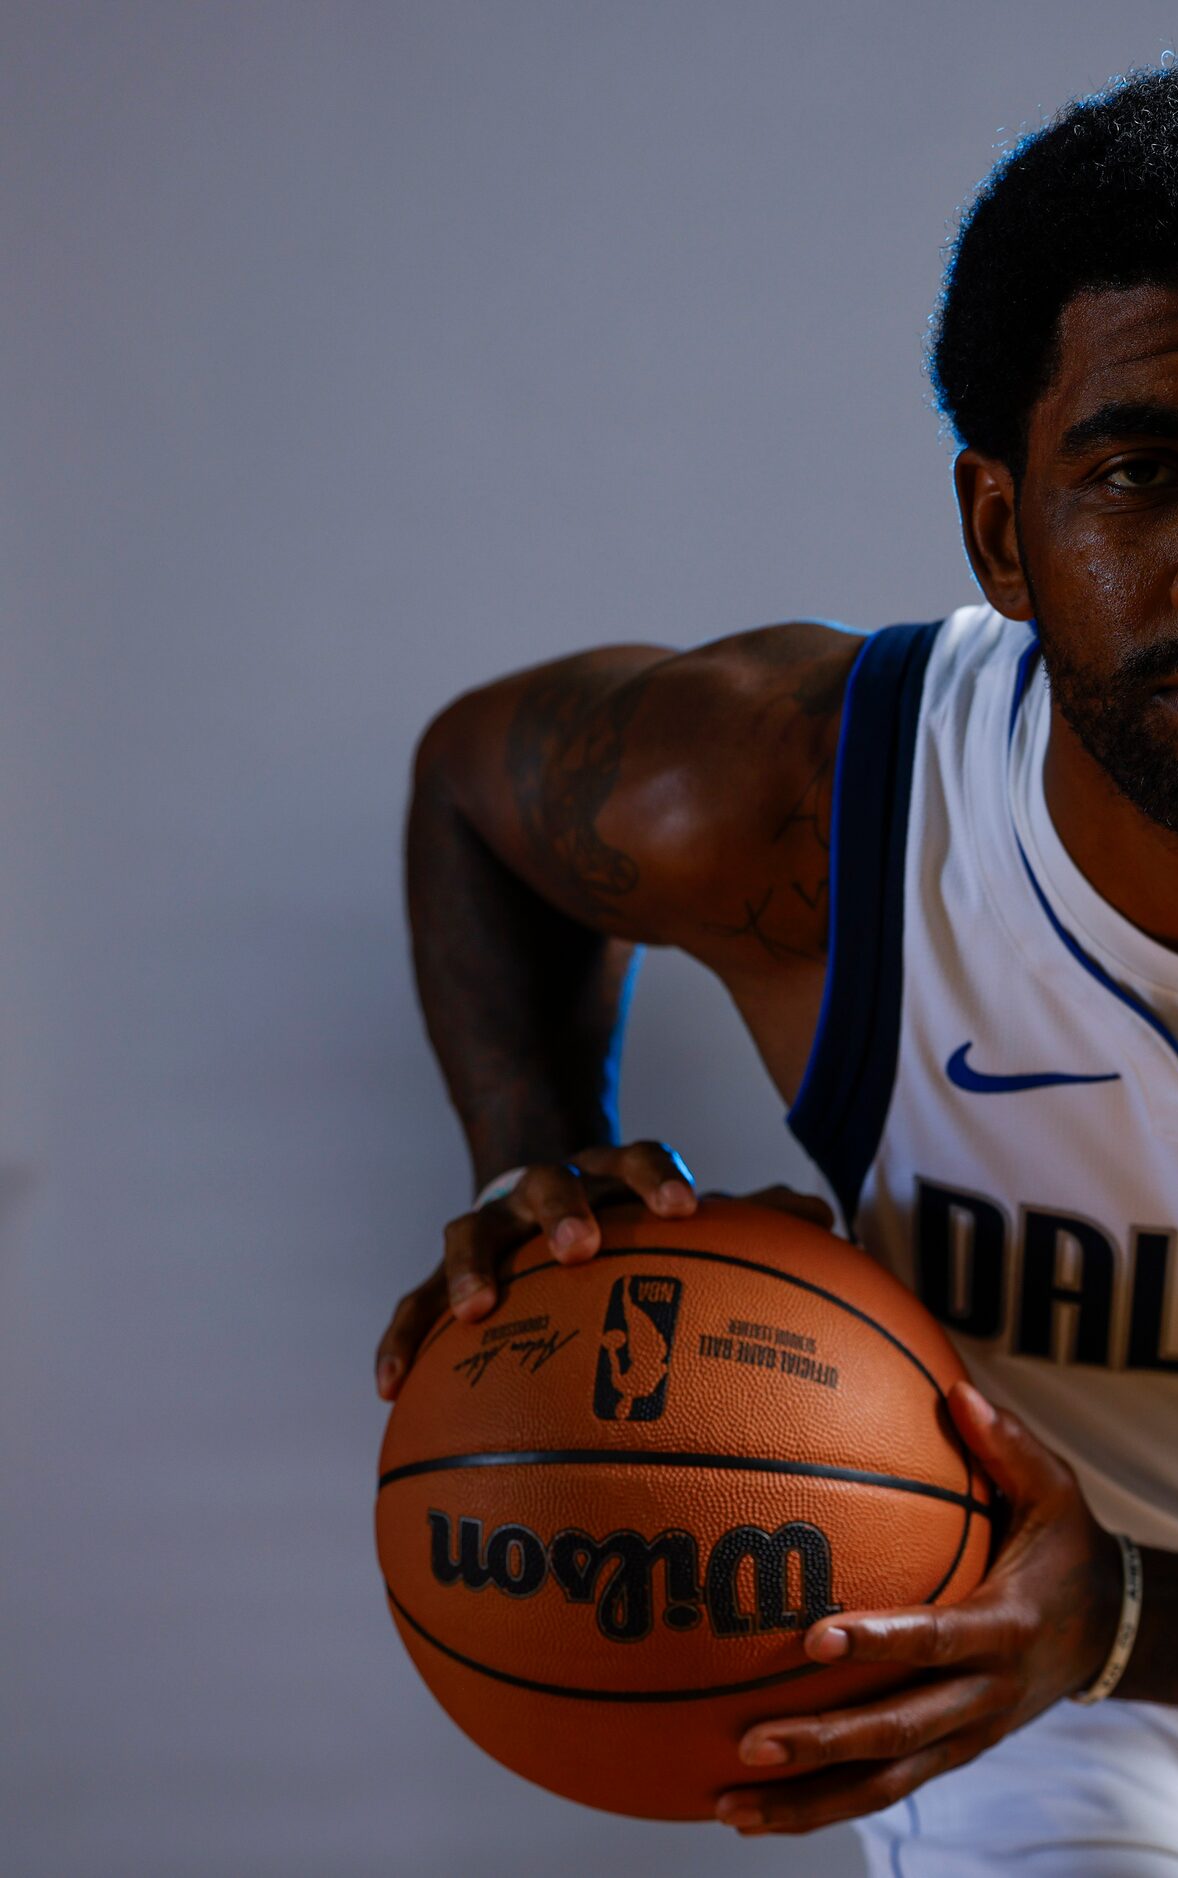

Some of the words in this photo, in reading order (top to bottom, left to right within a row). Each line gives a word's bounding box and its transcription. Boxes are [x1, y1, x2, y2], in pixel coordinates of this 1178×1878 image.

[639, 1281, 675, 1303] NBA
[699, 1334, 733, 1360] BALL
[737, 1340, 776, 1369] GAME
[781, 1350, 838, 1389] OFFICIAL
[429, 1511, 842, 1641] Wilson
